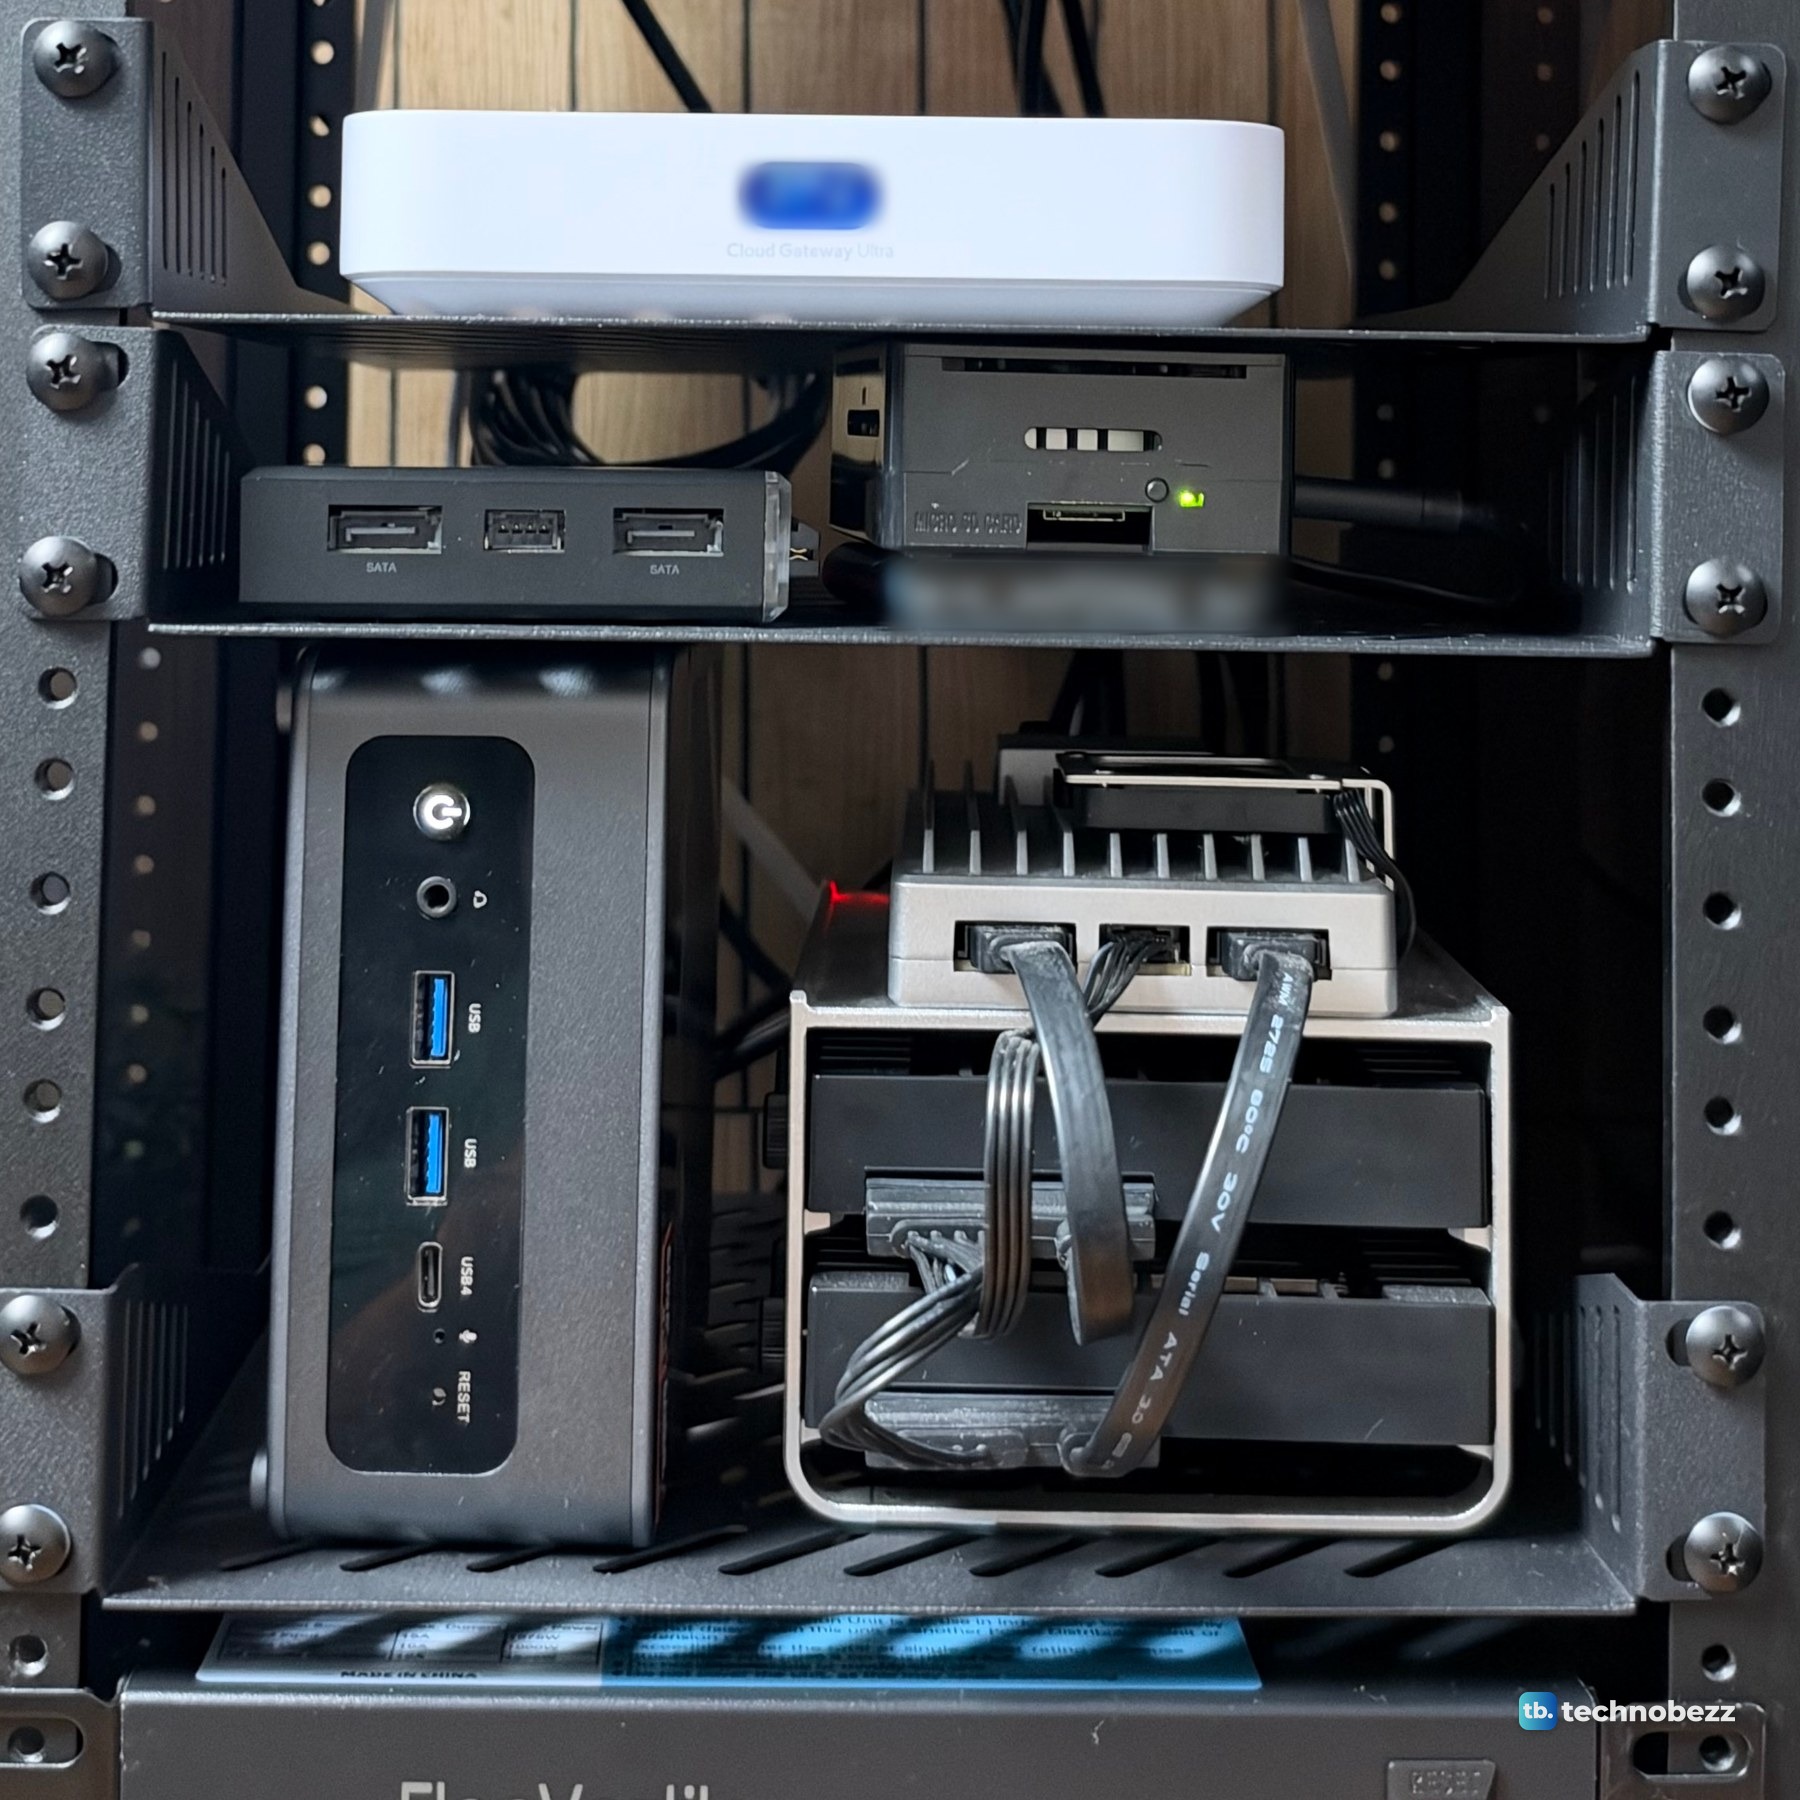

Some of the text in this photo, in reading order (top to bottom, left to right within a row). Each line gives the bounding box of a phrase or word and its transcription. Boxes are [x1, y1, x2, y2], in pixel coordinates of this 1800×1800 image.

[365, 562, 397, 574] SATA
[649, 564, 680, 576] SATA
[1278, 972, 1293, 1006] AWM
[468, 1003, 482, 1033] USB
[464, 1138, 477, 1168] USB
[1211, 1171, 1238, 1233] 30V
[460, 1256, 473, 1296] USB4
[1178, 1251, 1210, 1316] Serial
[1149, 1331, 1179, 1381] ATA
[457, 1371, 471, 1424] RESET
